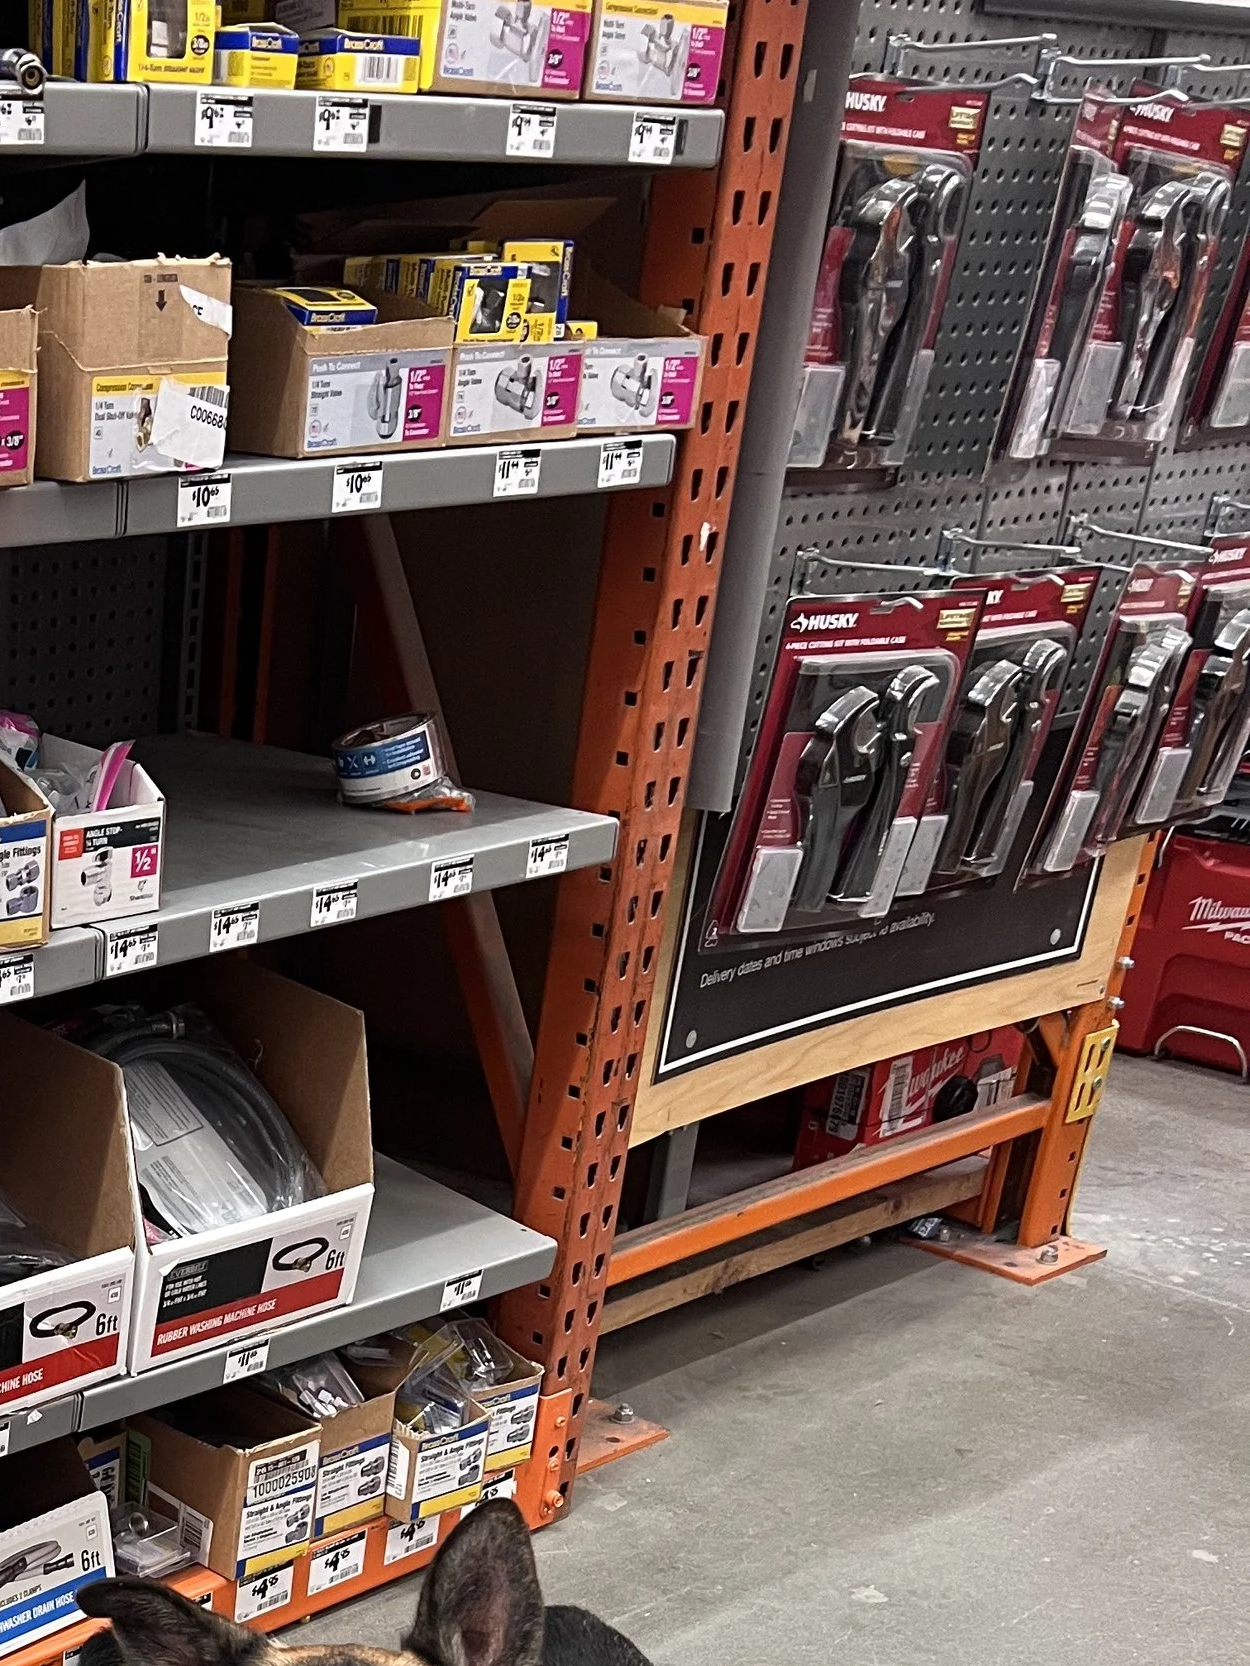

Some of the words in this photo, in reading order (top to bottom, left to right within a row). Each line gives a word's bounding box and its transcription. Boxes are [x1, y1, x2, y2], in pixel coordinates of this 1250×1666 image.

[846, 93, 888, 112] HUSKY
[1137, 103, 1175, 122] HUSKY
[808, 612, 859, 630] HUSKY
[890, 636, 906, 645] CASE
[12, 845, 41, 858] Fittings
[700, 969, 736, 989] Delivery
[737, 958, 763, 976] dates
[764, 954, 782, 970] and
[783, 948, 803, 964] time
[805, 934, 844, 956] windows
[96, 1312, 118, 1338] 6ft
[22, 1368, 44, 1387] HOSE
[81, 1549, 101, 1573] 6ft
[32, 1600, 56, 1619] DRAIN
[56, 1590, 76, 1608] HOSE
